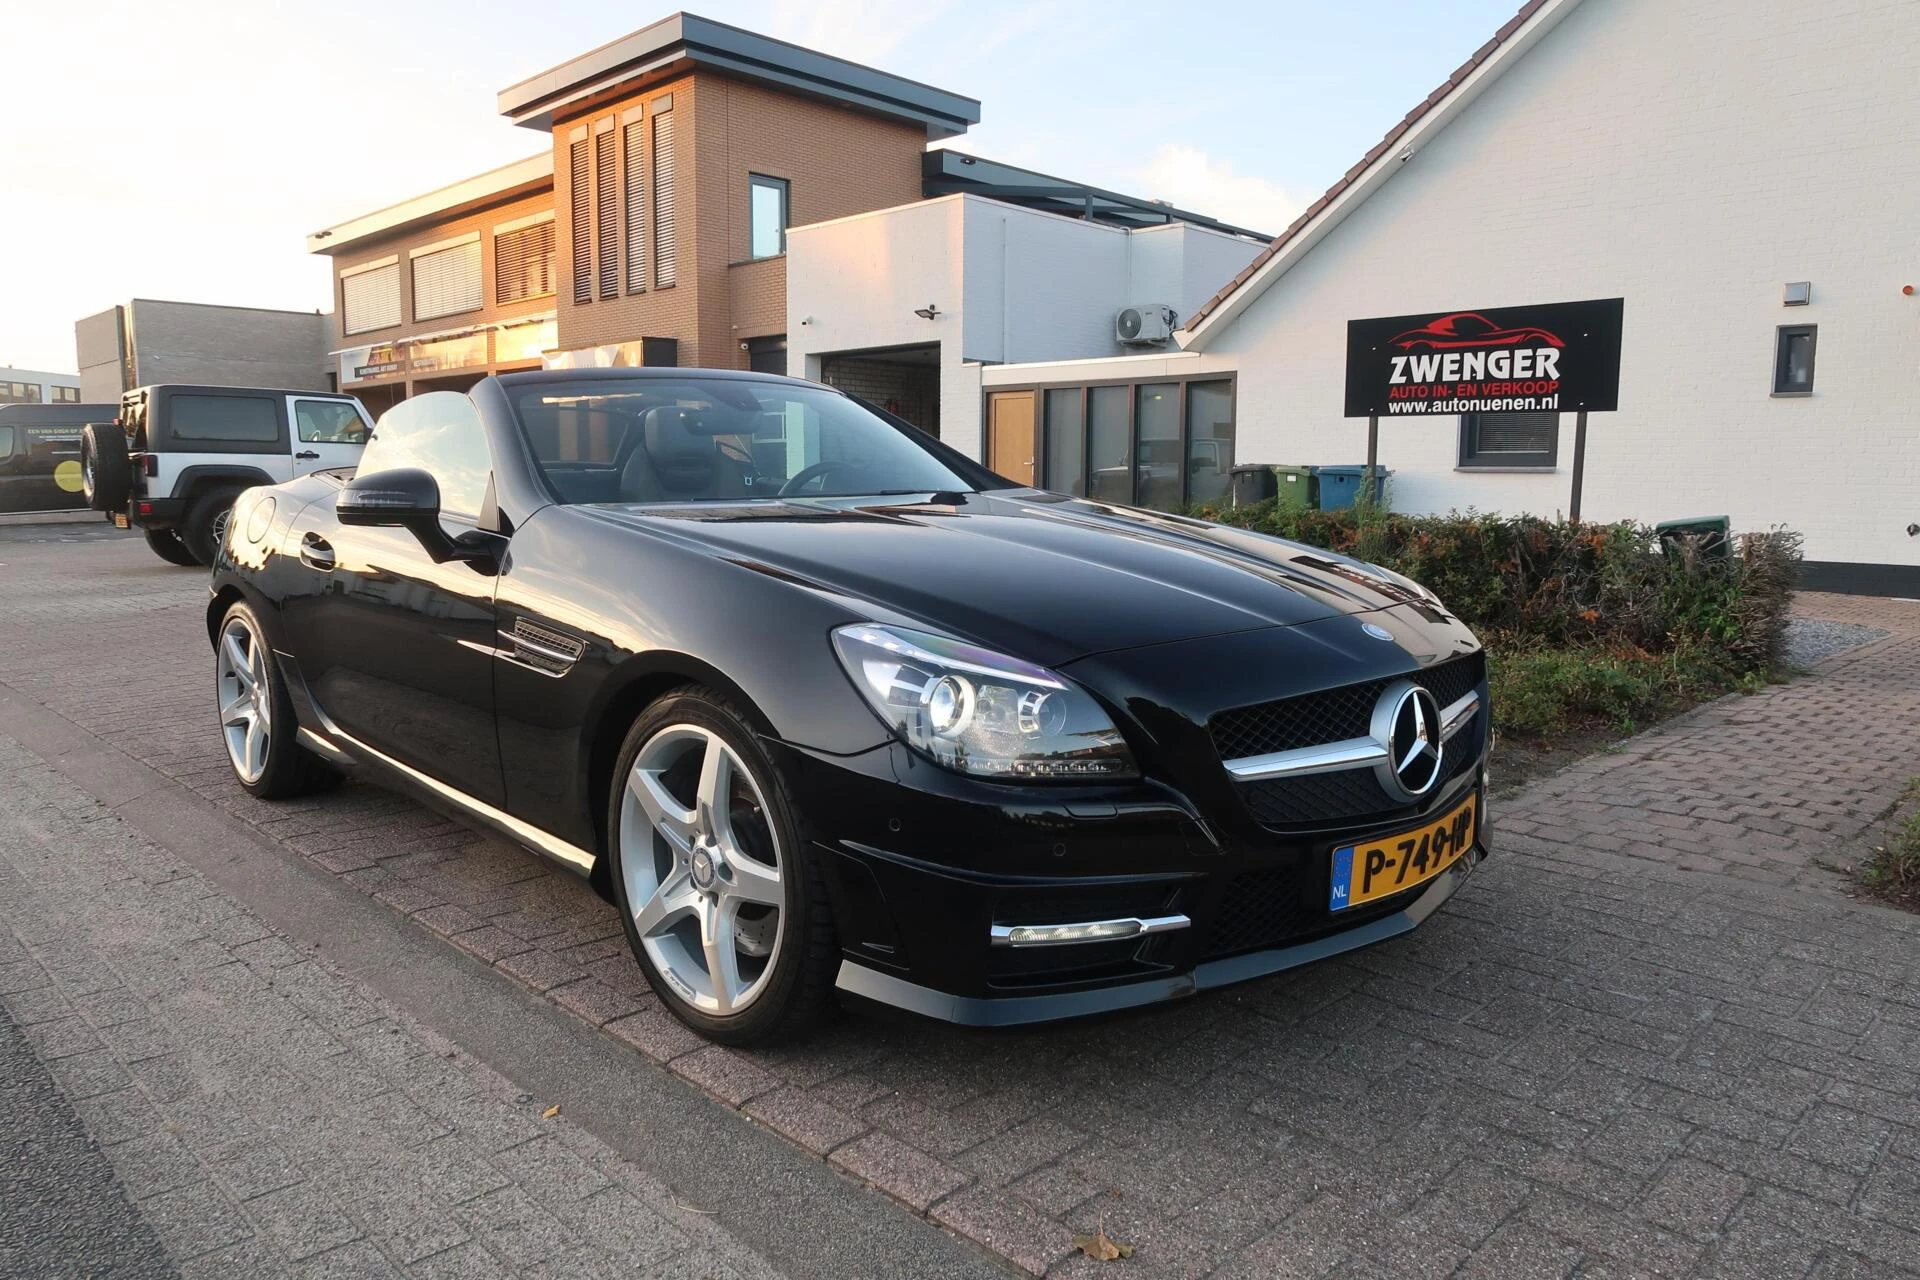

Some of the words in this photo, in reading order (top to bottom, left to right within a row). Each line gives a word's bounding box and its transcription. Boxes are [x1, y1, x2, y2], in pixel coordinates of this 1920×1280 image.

[1389, 348, 1560, 384] ZWENGER
[1389, 385, 1428, 399] AUTO
[1433, 384, 1453, 397] IN-
[1457, 383, 1478, 397] EN
[1482, 380, 1559, 396] VERKOOP
[1389, 394, 1559, 413] www.autonuenen.nl
[1332, 885, 1347, 900] NL
